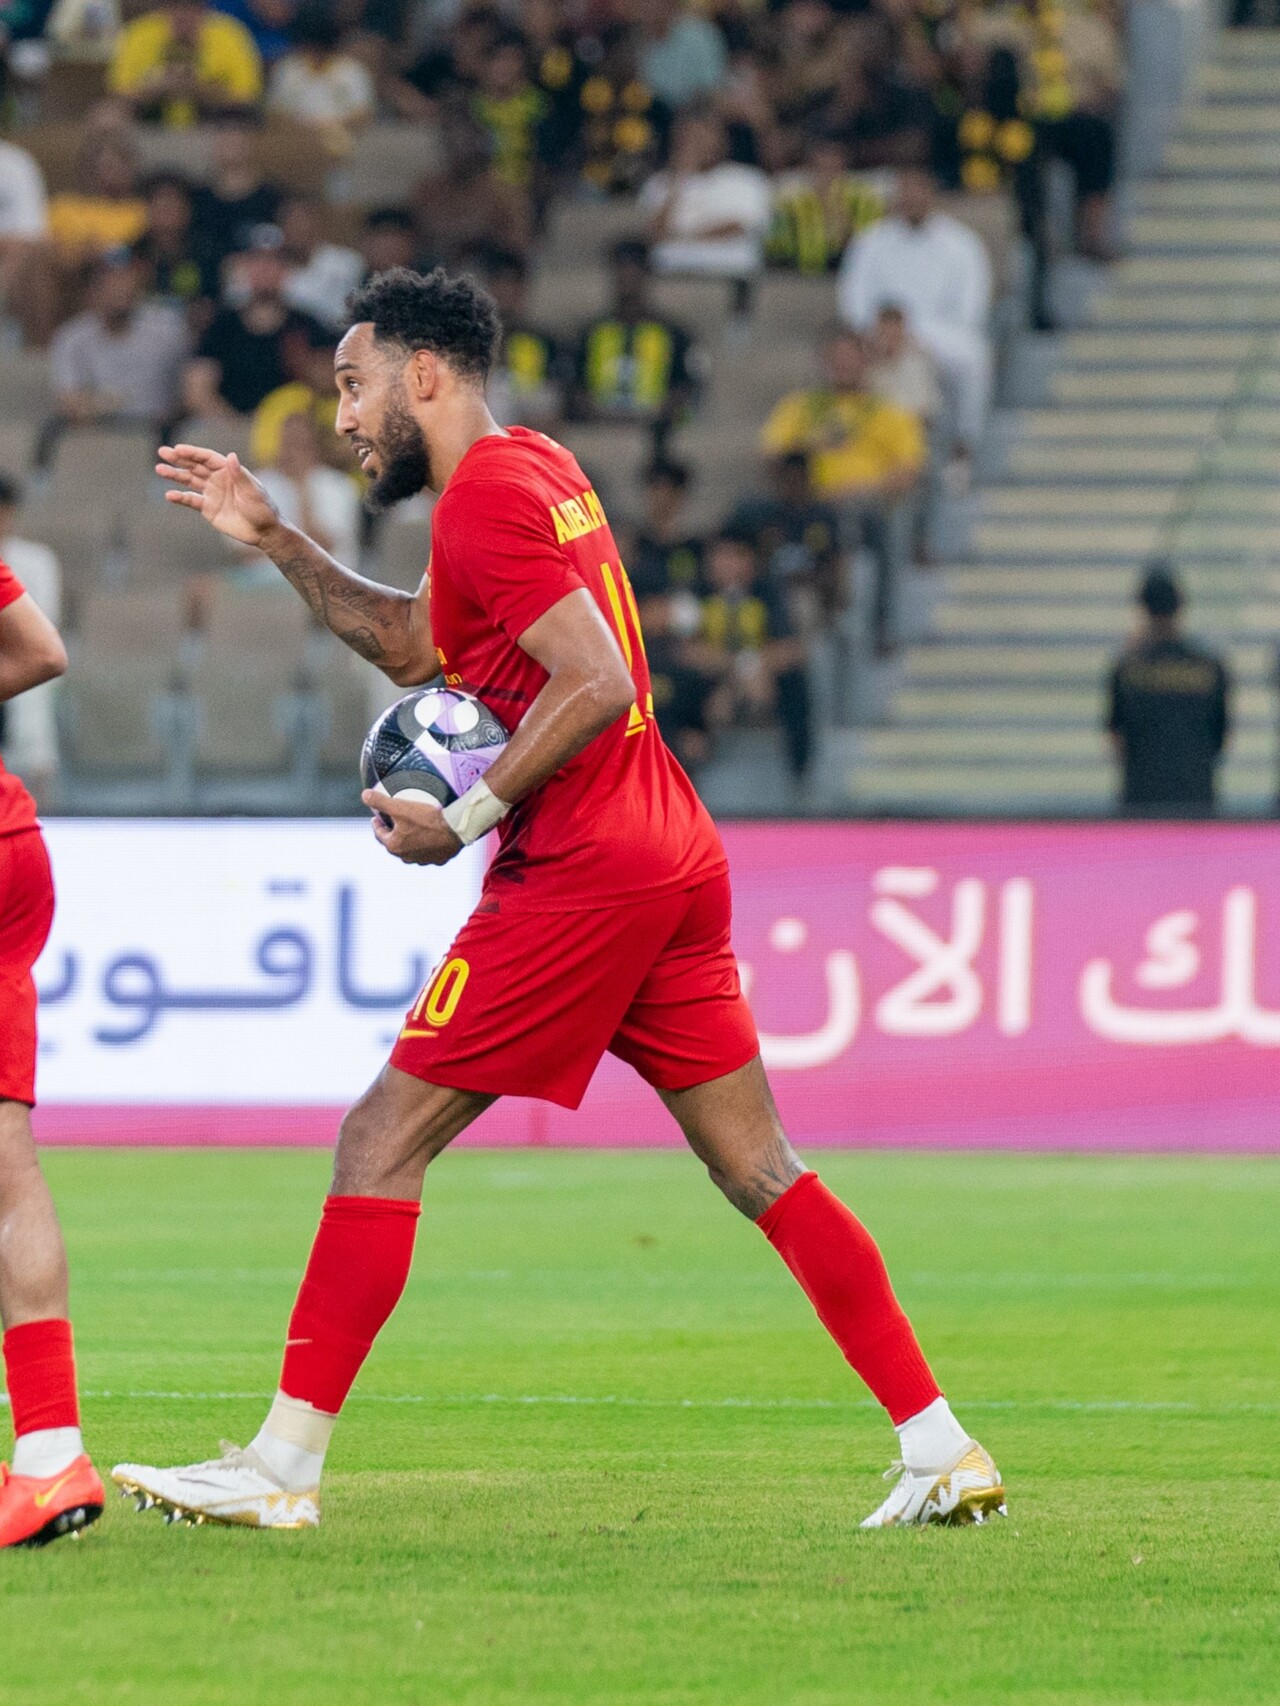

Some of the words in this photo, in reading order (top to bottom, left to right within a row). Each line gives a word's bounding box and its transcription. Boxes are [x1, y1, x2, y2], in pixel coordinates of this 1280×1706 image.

[412, 956, 469, 1027] 10
[736, 866, 1034, 1069] الآن
[1079, 884, 1280, 1047] لك
